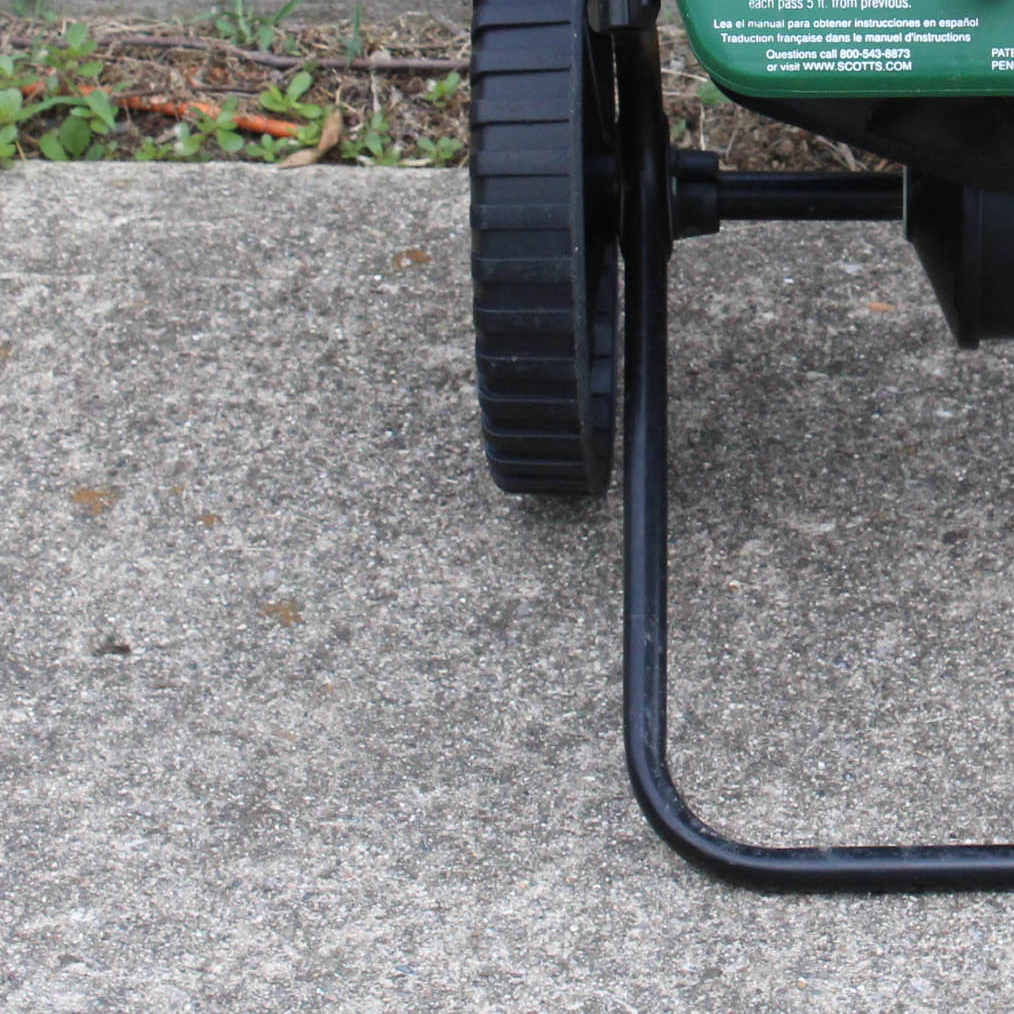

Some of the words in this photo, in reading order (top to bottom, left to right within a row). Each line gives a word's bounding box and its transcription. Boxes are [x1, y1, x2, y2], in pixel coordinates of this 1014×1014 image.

[713, 19, 733, 29] Lea
[736, 19, 745, 29] el
[747, 19, 785, 28] manual
[788, 20, 810, 30] para
[813, 18, 852, 28] obtener
[854, 18, 921, 28] instrucciones
[923, 19, 937, 28] en
[938, 18, 978, 29] español
[720, 33, 774, 43] Traduction
[777, 33, 823, 45] française
[825, 33, 851, 43] dans
[852, 33, 863, 42] le
[864, 32, 902, 42] manuel
[905, 32, 971, 42] d'instructions
[766, 49, 817, 59] Questions
[819, 49, 838, 59] call
[840, 48, 911, 59] 800-543-8873
[779, 62, 800, 71] visit
[802, 61, 912, 71] WWW.SCOTTS.COM
